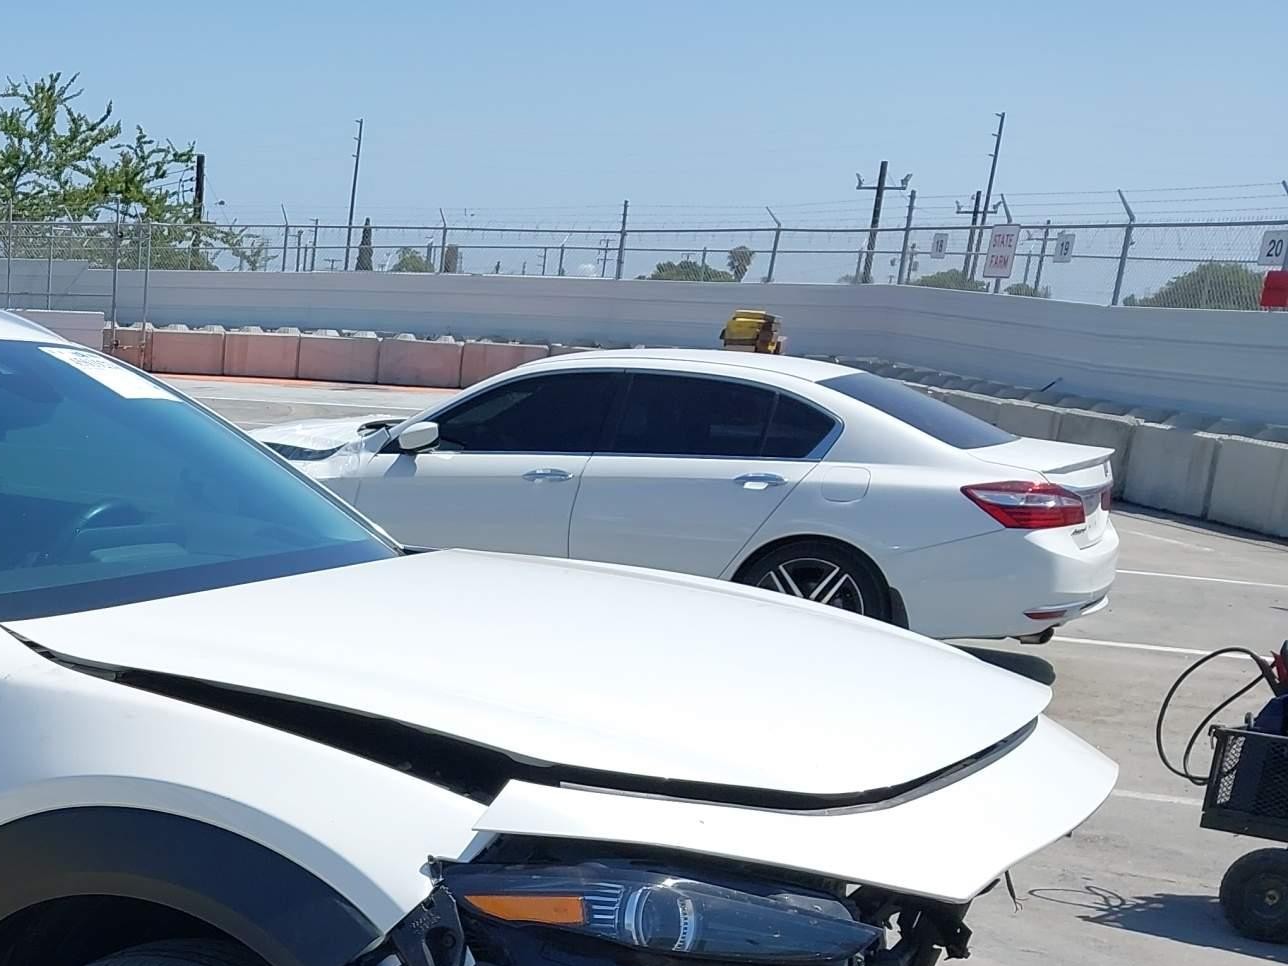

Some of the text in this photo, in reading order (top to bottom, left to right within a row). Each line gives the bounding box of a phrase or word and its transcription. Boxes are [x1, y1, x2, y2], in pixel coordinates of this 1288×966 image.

[992, 233, 1015, 248] STATE
[1265, 239, 1284, 257] 20
[1060, 241, 1070, 256] 19
[989, 255, 1009, 268] FARM
